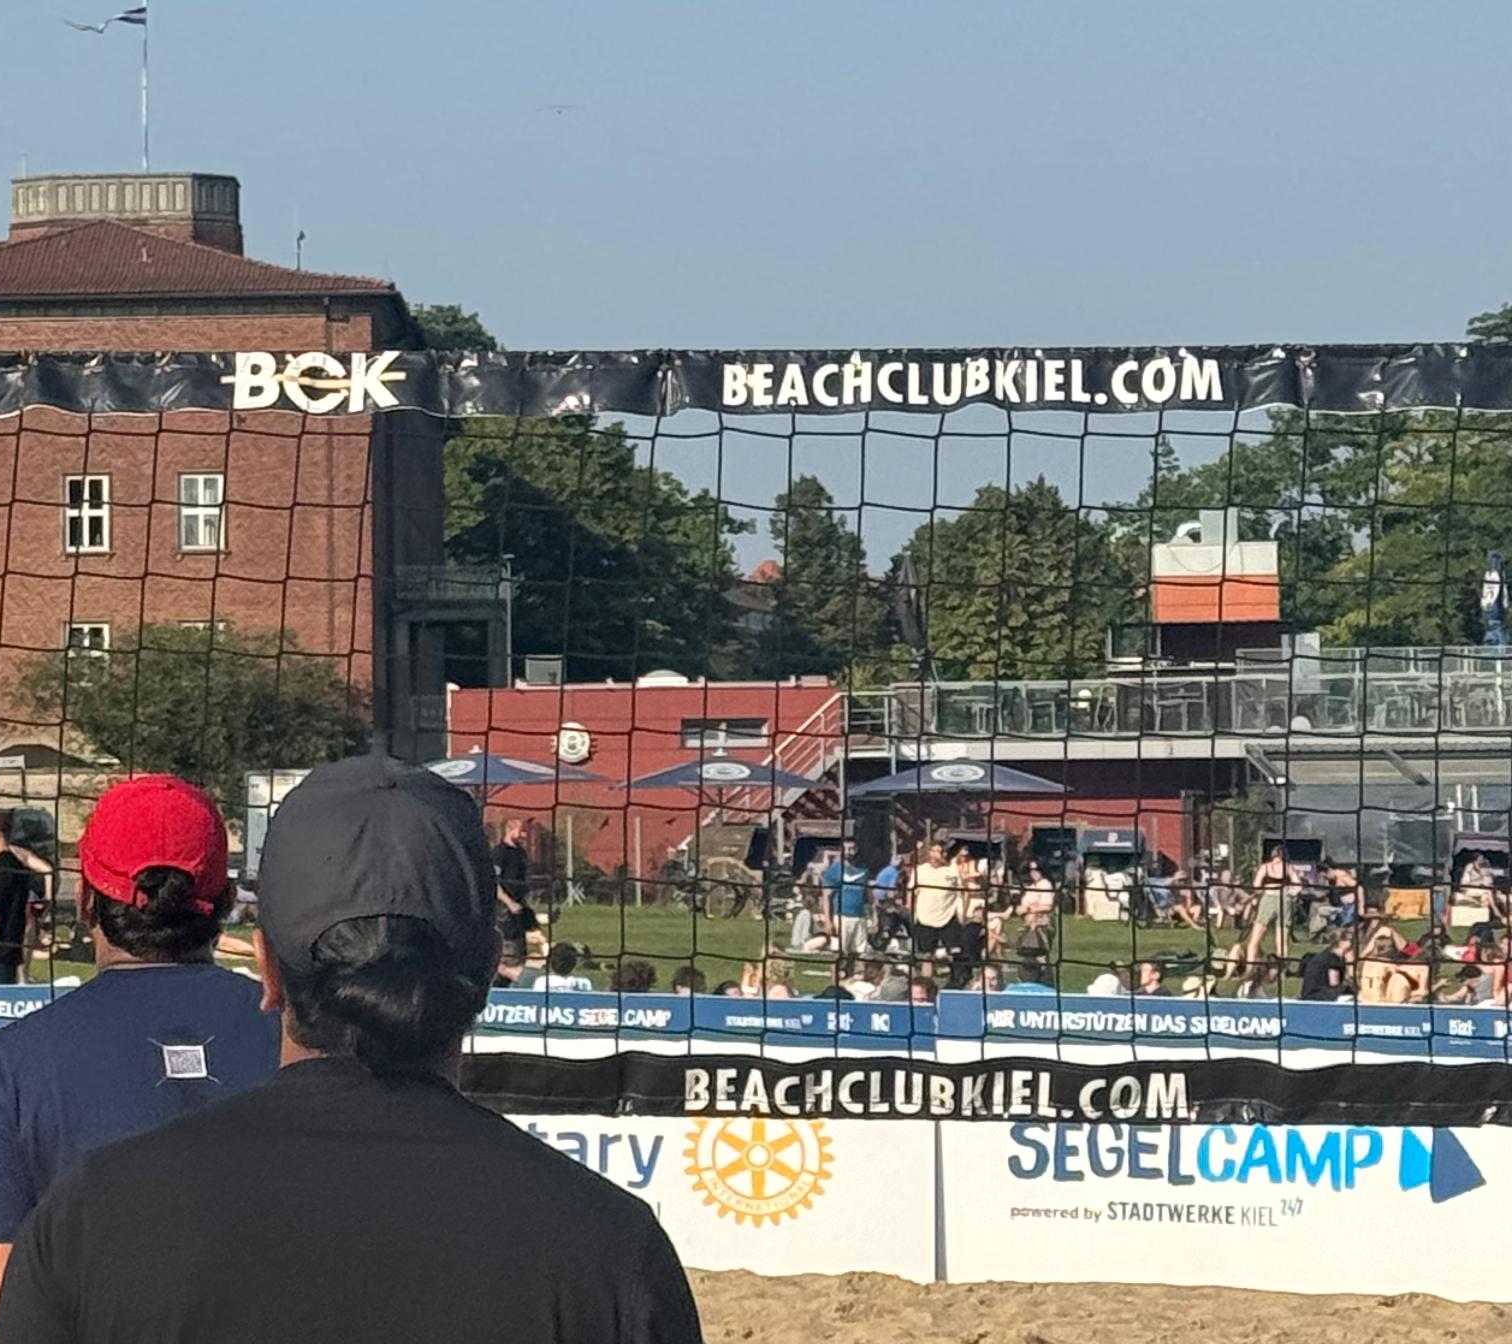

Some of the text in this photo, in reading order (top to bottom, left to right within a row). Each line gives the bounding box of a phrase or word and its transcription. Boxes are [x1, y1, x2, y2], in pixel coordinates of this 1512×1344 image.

[722, 358, 1225, 407] BEACHCLUBKIEL.COM
[578, 1008, 672, 1027] SEGECAMP
[1151, 1014, 1187, 1034] DAS
[684, 1068, 1189, 1119] BEACHCLUBKIEL.COM
[527, 1122, 664, 1189] ary
[1008, 1122, 1383, 1192] SEGELCAMP
[1010, 1207, 1079, 1219] powered
[1083, 1207, 1102, 1223] by
[1106, 1201, 1236, 1225] STADTWERKE
[1240, 1206, 1278, 1227] KIEL
